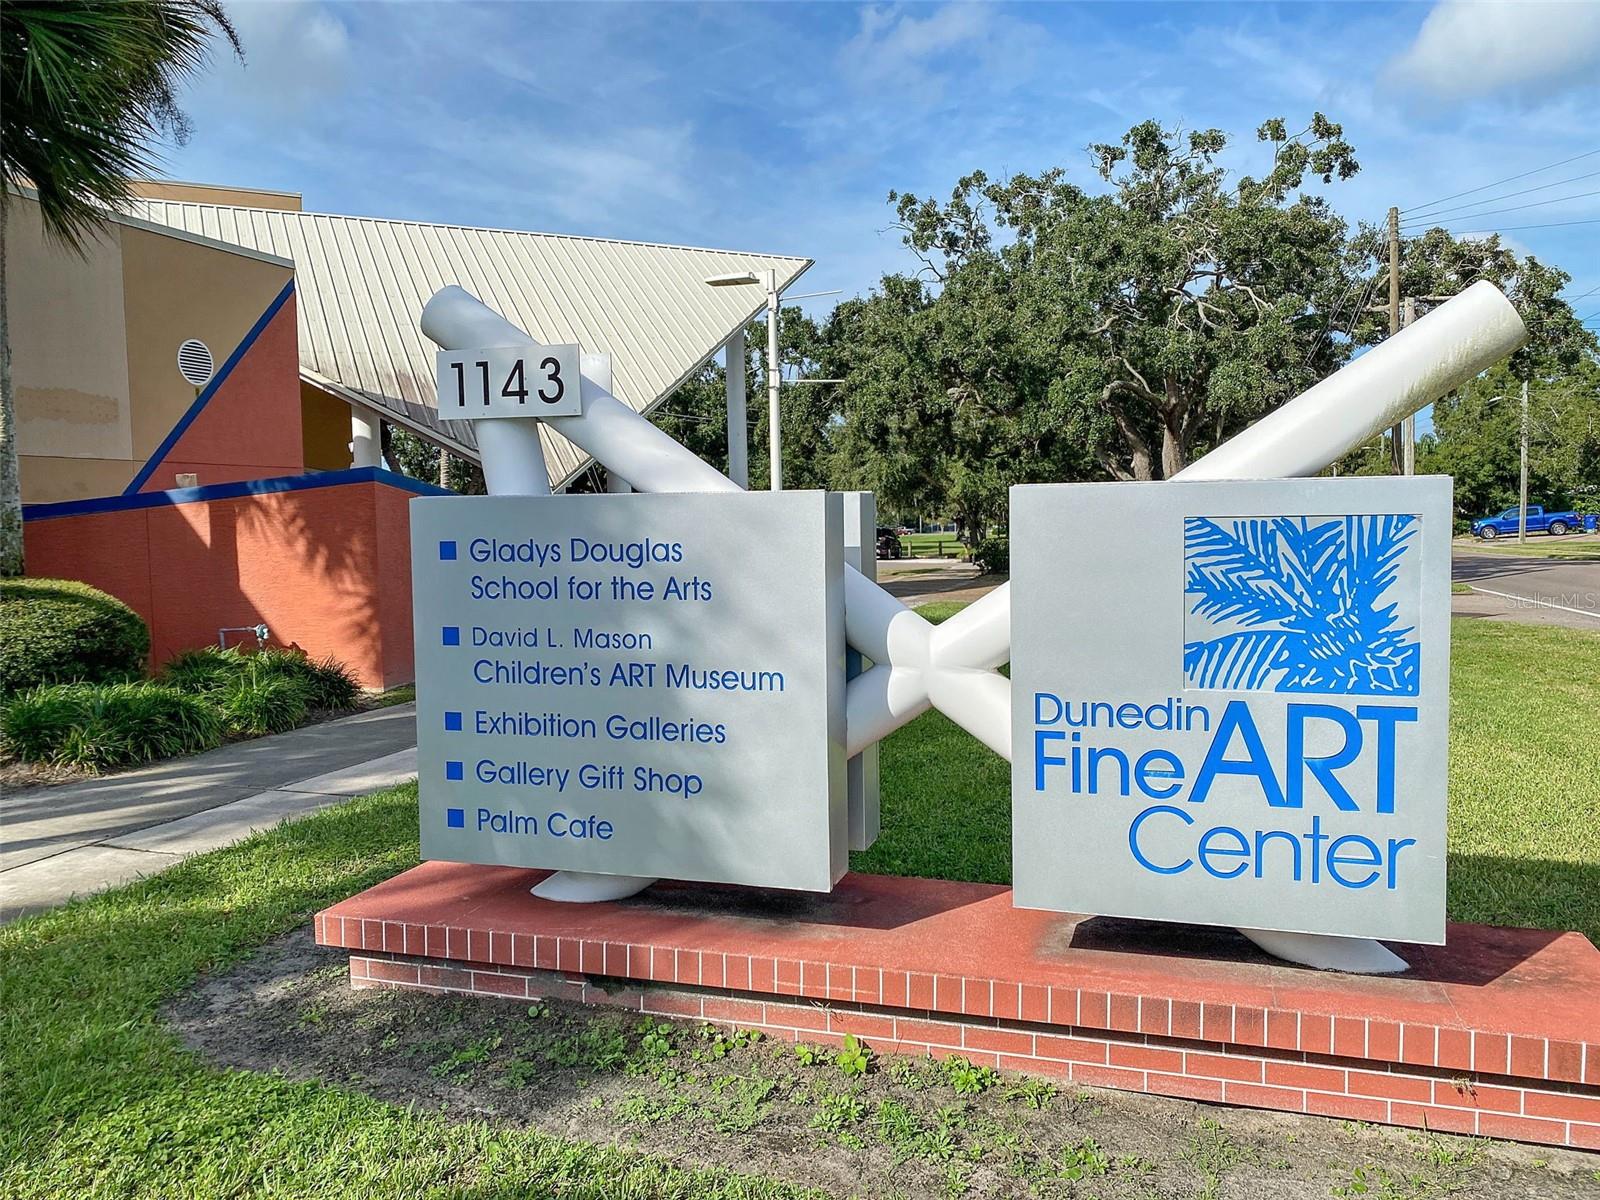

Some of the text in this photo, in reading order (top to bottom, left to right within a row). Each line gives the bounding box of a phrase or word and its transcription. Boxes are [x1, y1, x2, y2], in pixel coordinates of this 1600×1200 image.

[450, 357, 564, 407] 1143
[469, 537, 683, 568] Gladys Douglas
[471, 575, 712, 601] School for the Arts
[472, 627, 652, 650] David L. Mason
[473, 659, 785, 691] Children's ART Museum
[475, 711, 727, 744] Exhibition Galleries
[1034, 693, 1209, 731] Dunedin
[1035, 700, 1418, 814] Fine ART
[475, 759, 703, 799] Gallery Gift Shop
[477, 808, 614, 840] Palm Cafe
[1128, 804, 1417, 889] Center
